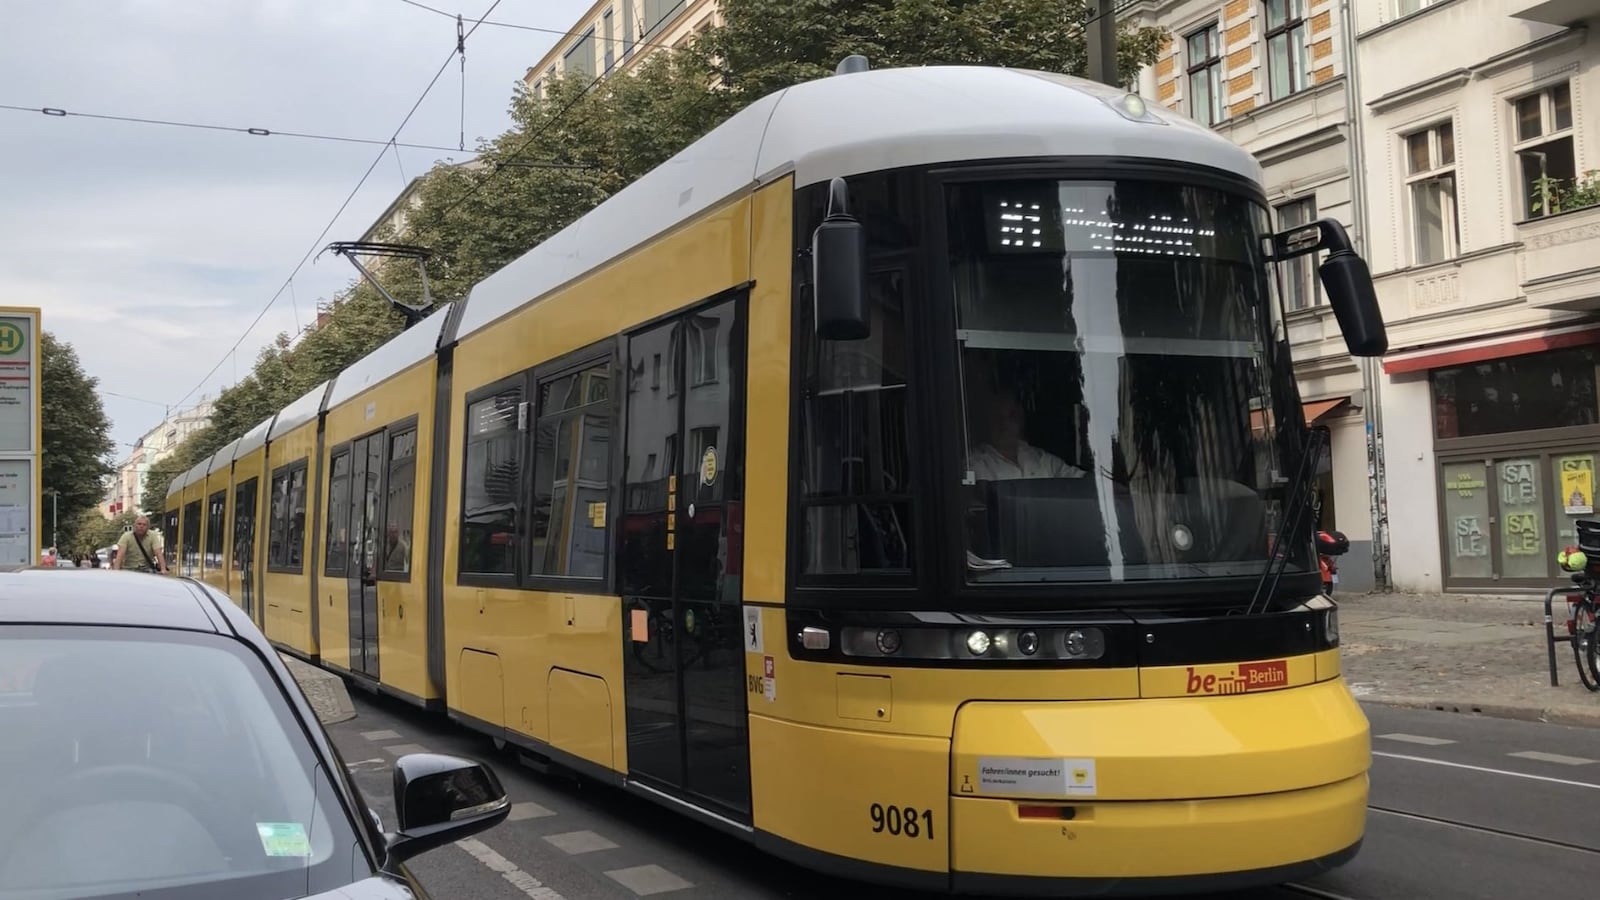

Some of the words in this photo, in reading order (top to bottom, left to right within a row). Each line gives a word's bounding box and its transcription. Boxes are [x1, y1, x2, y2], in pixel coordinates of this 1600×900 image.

[748, 675, 764, 694] BVG
[1249, 668, 1284, 684] Berlin
[1028, 768, 1060, 778] gesucht!
[870, 803, 934, 840] 9081
